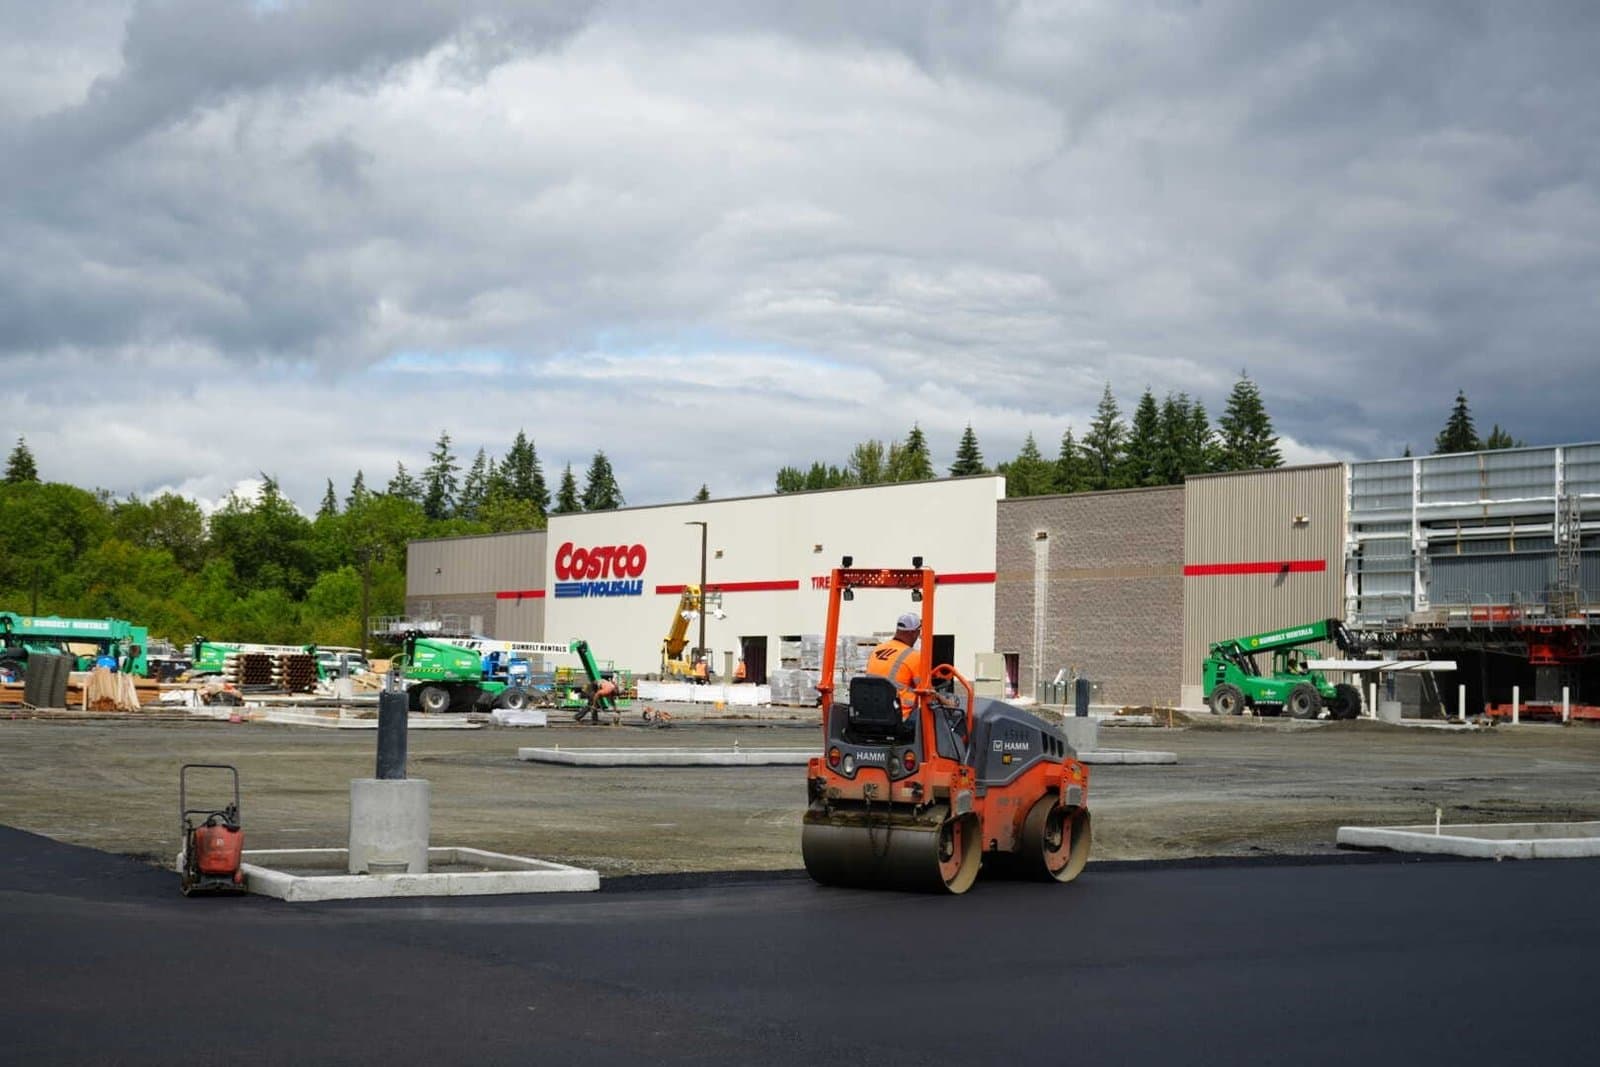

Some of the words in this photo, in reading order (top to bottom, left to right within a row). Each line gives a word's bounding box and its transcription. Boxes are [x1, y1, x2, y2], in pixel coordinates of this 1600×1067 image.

[555, 542, 646, 581] COSTCO
[580, 580, 643, 598] WHOLESALE
[811, 576, 831, 590] TIRE
[511, 643, 539, 651] SUNBELT
[540, 644, 567, 653] RENTALS
[1004, 742, 1029, 750] HAMM
[856, 751, 885, 761] HAMM
